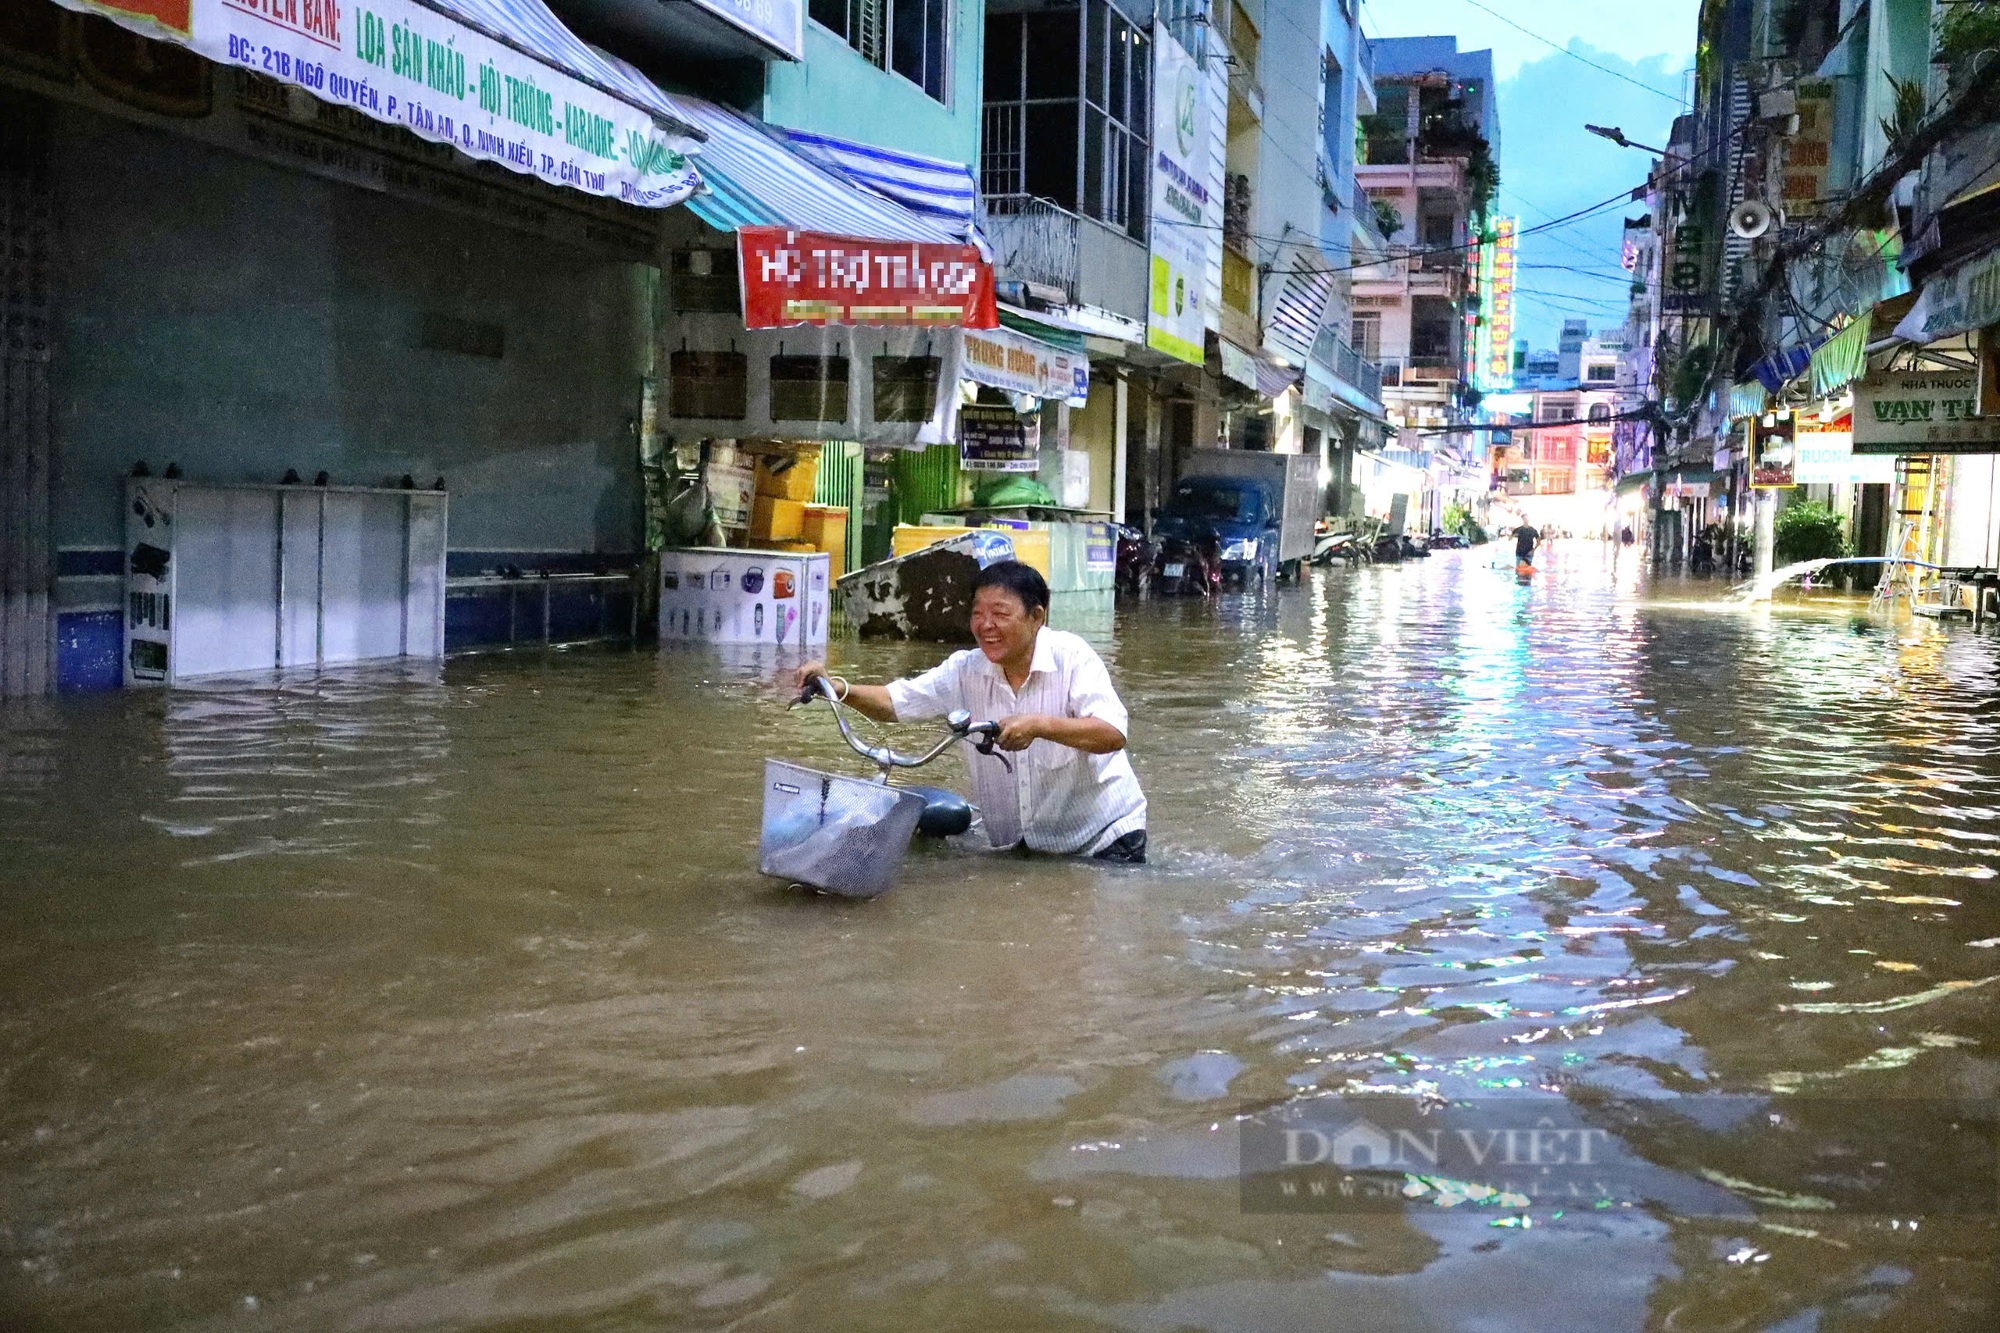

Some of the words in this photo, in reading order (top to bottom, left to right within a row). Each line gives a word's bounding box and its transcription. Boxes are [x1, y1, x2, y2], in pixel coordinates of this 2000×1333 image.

[228, 33, 256, 65] ĐC:
[262, 46, 291, 77] 21B
[295, 58, 324, 90] NGÔ
[329, 73, 383, 115] QUYỀN,
[388, 95, 402, 120] P.
[407, 101, 434, 131] TÂN
[438, 114, 458, 143] AN,
[462, 123, 474, 147] Q.
[478, 129, 505, 157] NINH
[507, 138, 538, 172] KIỀU,
[541, 153, 557, 177] TP.
[560, 160, 582, 186] CẦN
[583, 170, 606, 192] THƠ
[356, 7, 386, 68] LOA
[392, 17, 423, 84] SÂN
[427, 34, 465, 100] KHẤU
[479, 58, 501, 125] HỘI
[504, 74, 553, 137] TRƯỜNG
[564, 101, 619, 161] KARAOKE
